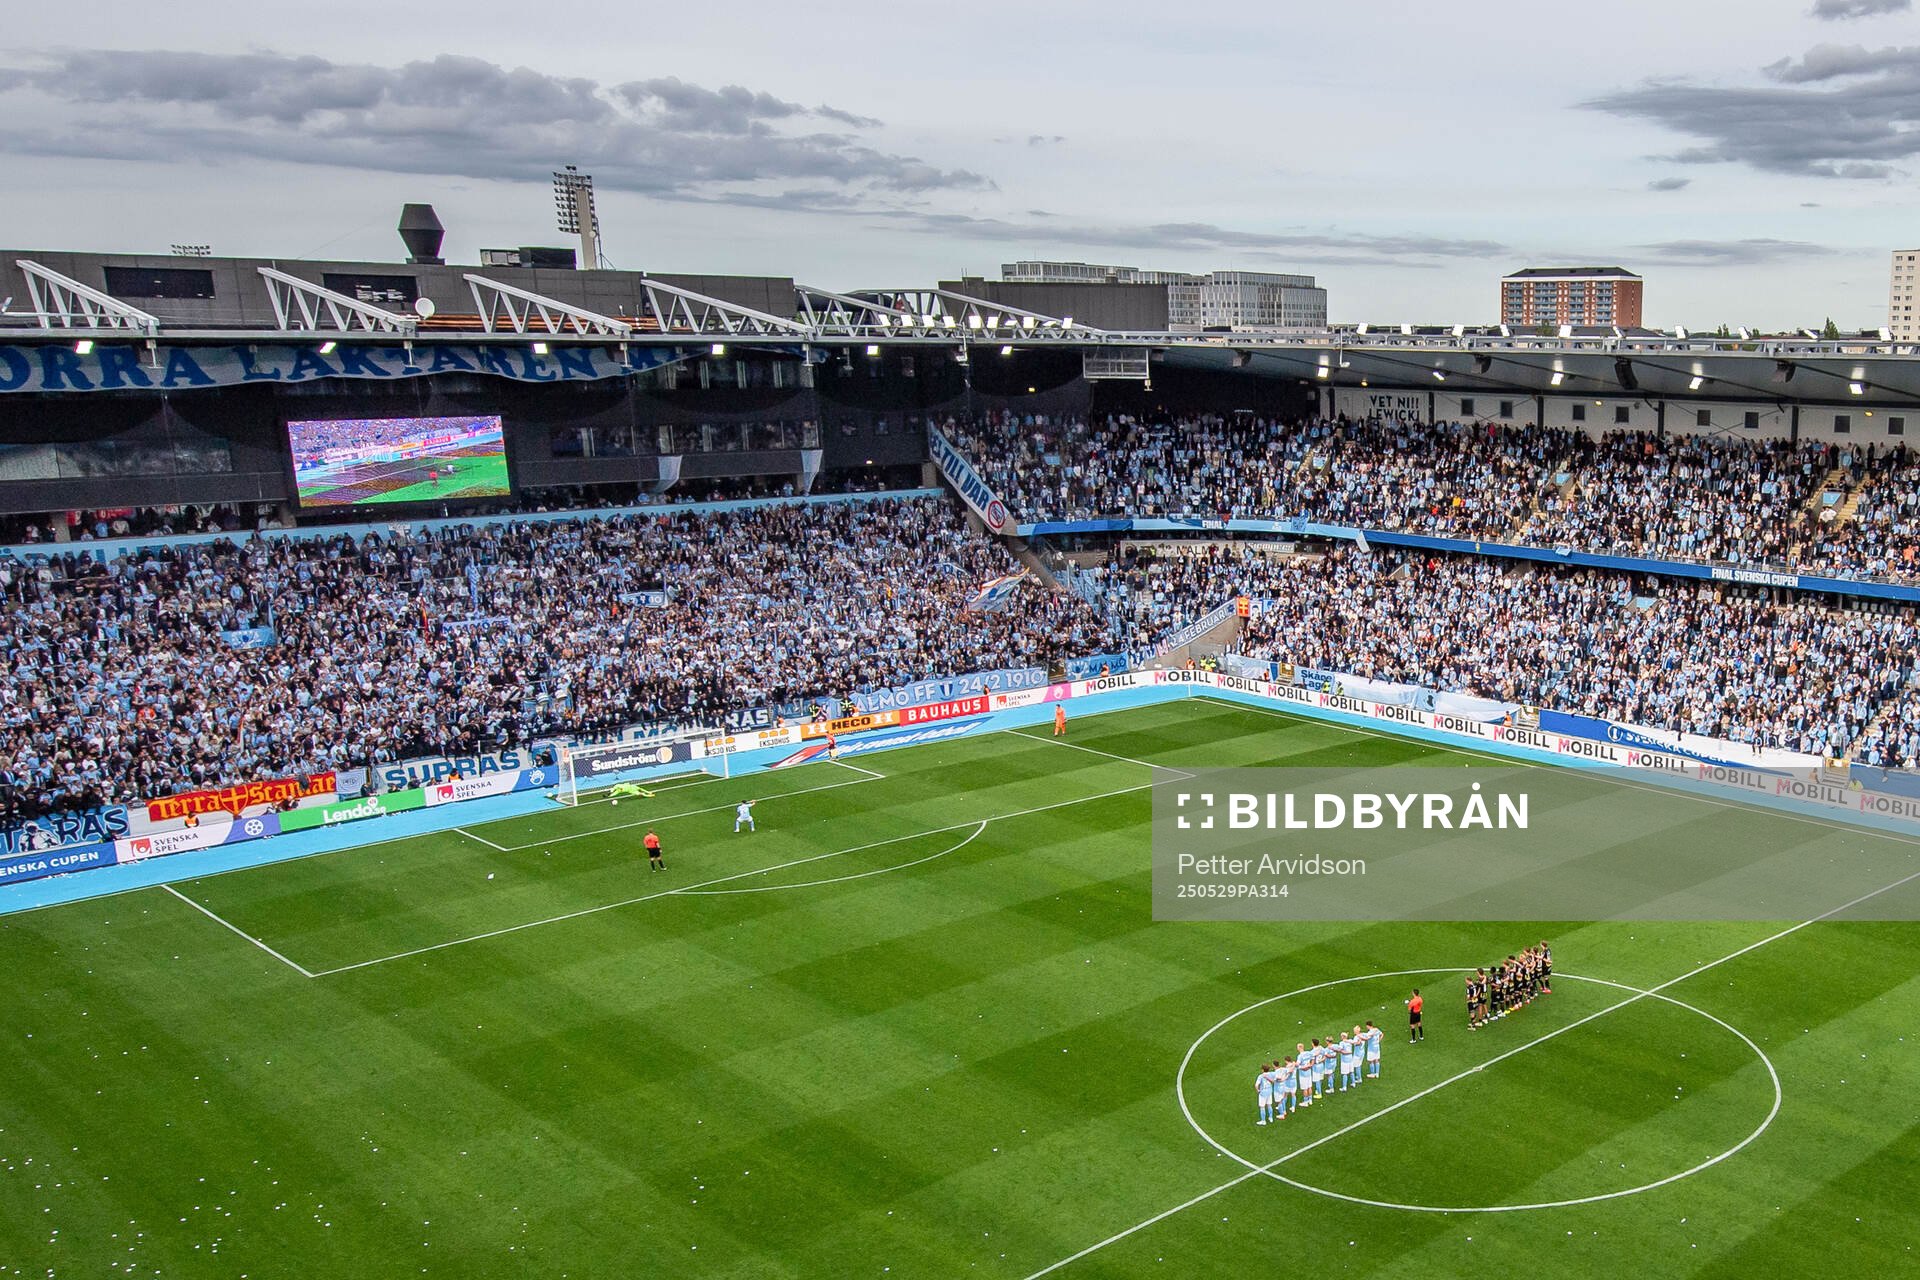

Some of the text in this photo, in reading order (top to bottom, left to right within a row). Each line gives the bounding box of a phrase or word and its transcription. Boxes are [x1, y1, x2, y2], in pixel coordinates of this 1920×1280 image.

[1370, 396, 1392, 408] VET
[1368, 408, 1419, 422] LEWICKI
[941, 447, 965, 484] TILL
[960, 471, 990, 512] VAR
[1202, 520, 1222, 529] FINAL
[1711, 568, 1798, 587] FINAL SVENSKA CUPEN
[1184, 607, 1228, 640] FEBRUARI
[1088, 656, 1127, 673] MAMÖ
[914, 683, 936, 702] FF
[958, 673, 1001, 695] 24/2
[1006, 670, 1043, 688] 1910
[1086, 674, 1137, 693] MOBILL
[1154, 671, 1211, 688] MOBILL
[1217, 675, 1261, 693] MOBILL
[1268, 684, 1312, 703] MOBILL
[1320, 693, 1368, 713] MOBILL
[908, 699, 982, 721] BAUHAUS
[1375, 704, 1425, 724] MOBILL
[832, 716, 871, 731] HECO
[1434, 715, 1485, 735] MOBILL
[1494, 726, 1550, 748] MOBILL
[1558, 738, 1618, 761] MOBILL
[385, 751, 521, 788] SUPRAS
[591, 751, 657, 771] Sundström
[1628, 751, 1688, 773] MOBILL
[1699, 764, 1766, 789] MOBILL
[456, 780, 492, 793] SVENSKA
[456, 790, 476, 799] SPEL
[1776, 777, 1848, 805] MOBILL
[149, 794, 222, 820] Terra
[154, 832, 200, 847] SVENSKA
[155, 844, 179, 853] SPEL
[50, 851, 99, 867] CUPEN
